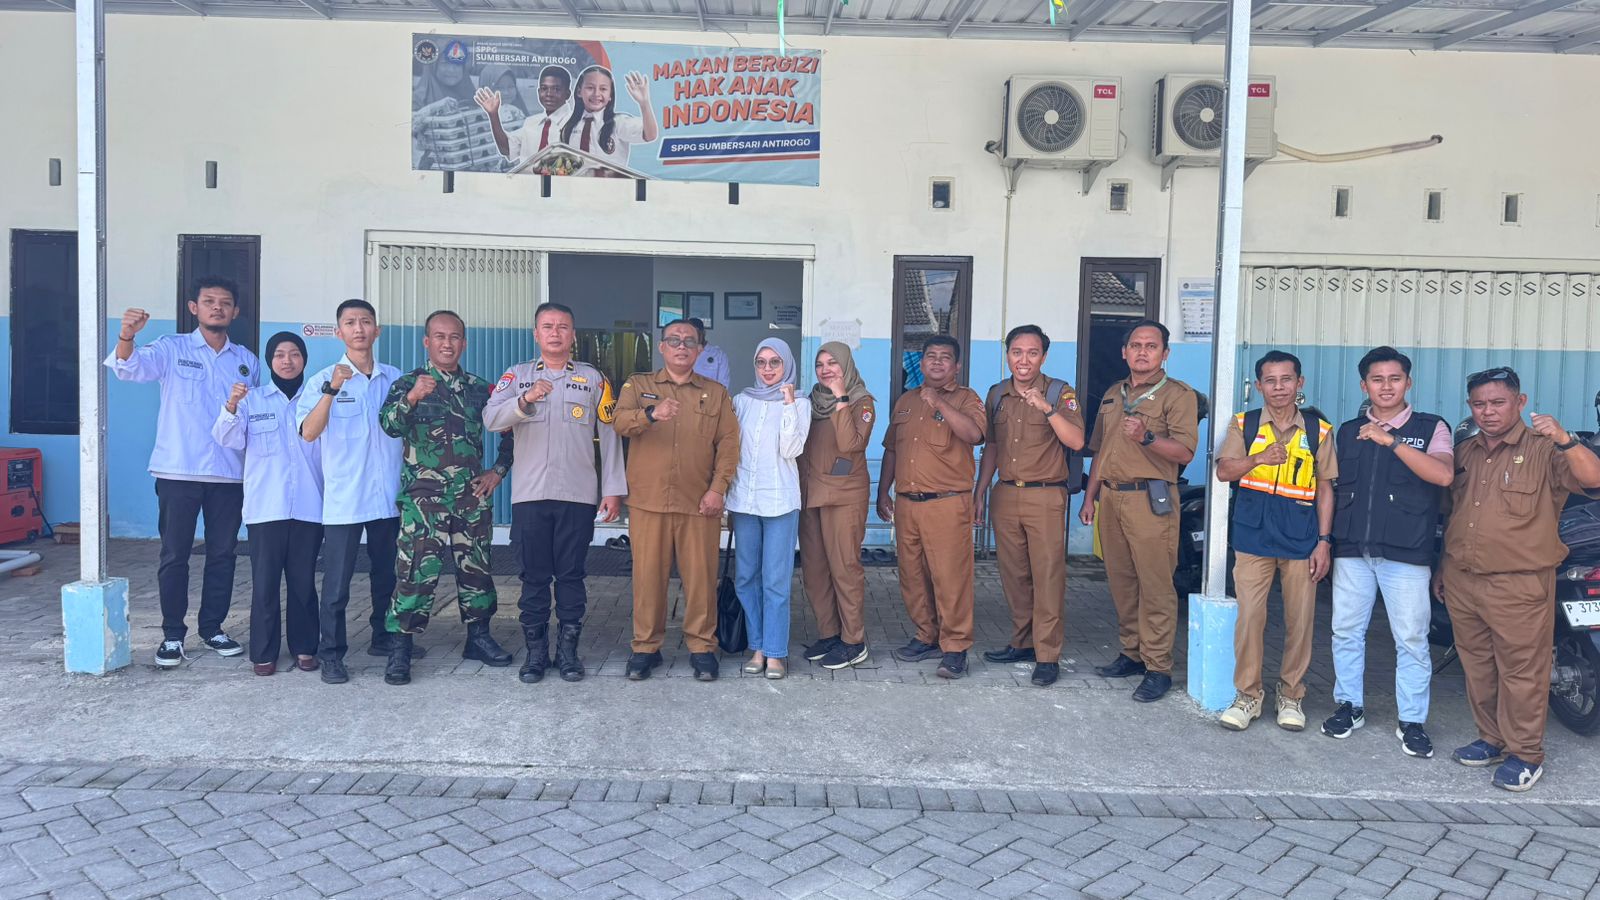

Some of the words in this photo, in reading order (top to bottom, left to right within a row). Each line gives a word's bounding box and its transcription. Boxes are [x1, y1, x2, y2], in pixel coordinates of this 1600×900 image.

[475, 46, 498, 54] SPPG
[475, 53, 530, 63] SUMBERSARI
[531, 56, 577, 65] ANTIROGO
[653, 56, 729, 81] MAKAN
[733, 55, 819, 74] BERGIZI
[674, 76, 726, 101] HAK
[728, 76, 799, 98] ANAK
[1096, 88, 1113, 96] TCL
[662, 99, 815, 129] INDONESIA
[670, 144, 697, 152] SPPG
[698, 139, 761, 151] SUMBERSARI
[762, 138, 811, 148] ANTIROGO
[566, 383, 591, 392] POLRI
[1565, 603, 1573, 614] P
[1578, 602, 1600, 613] 373
